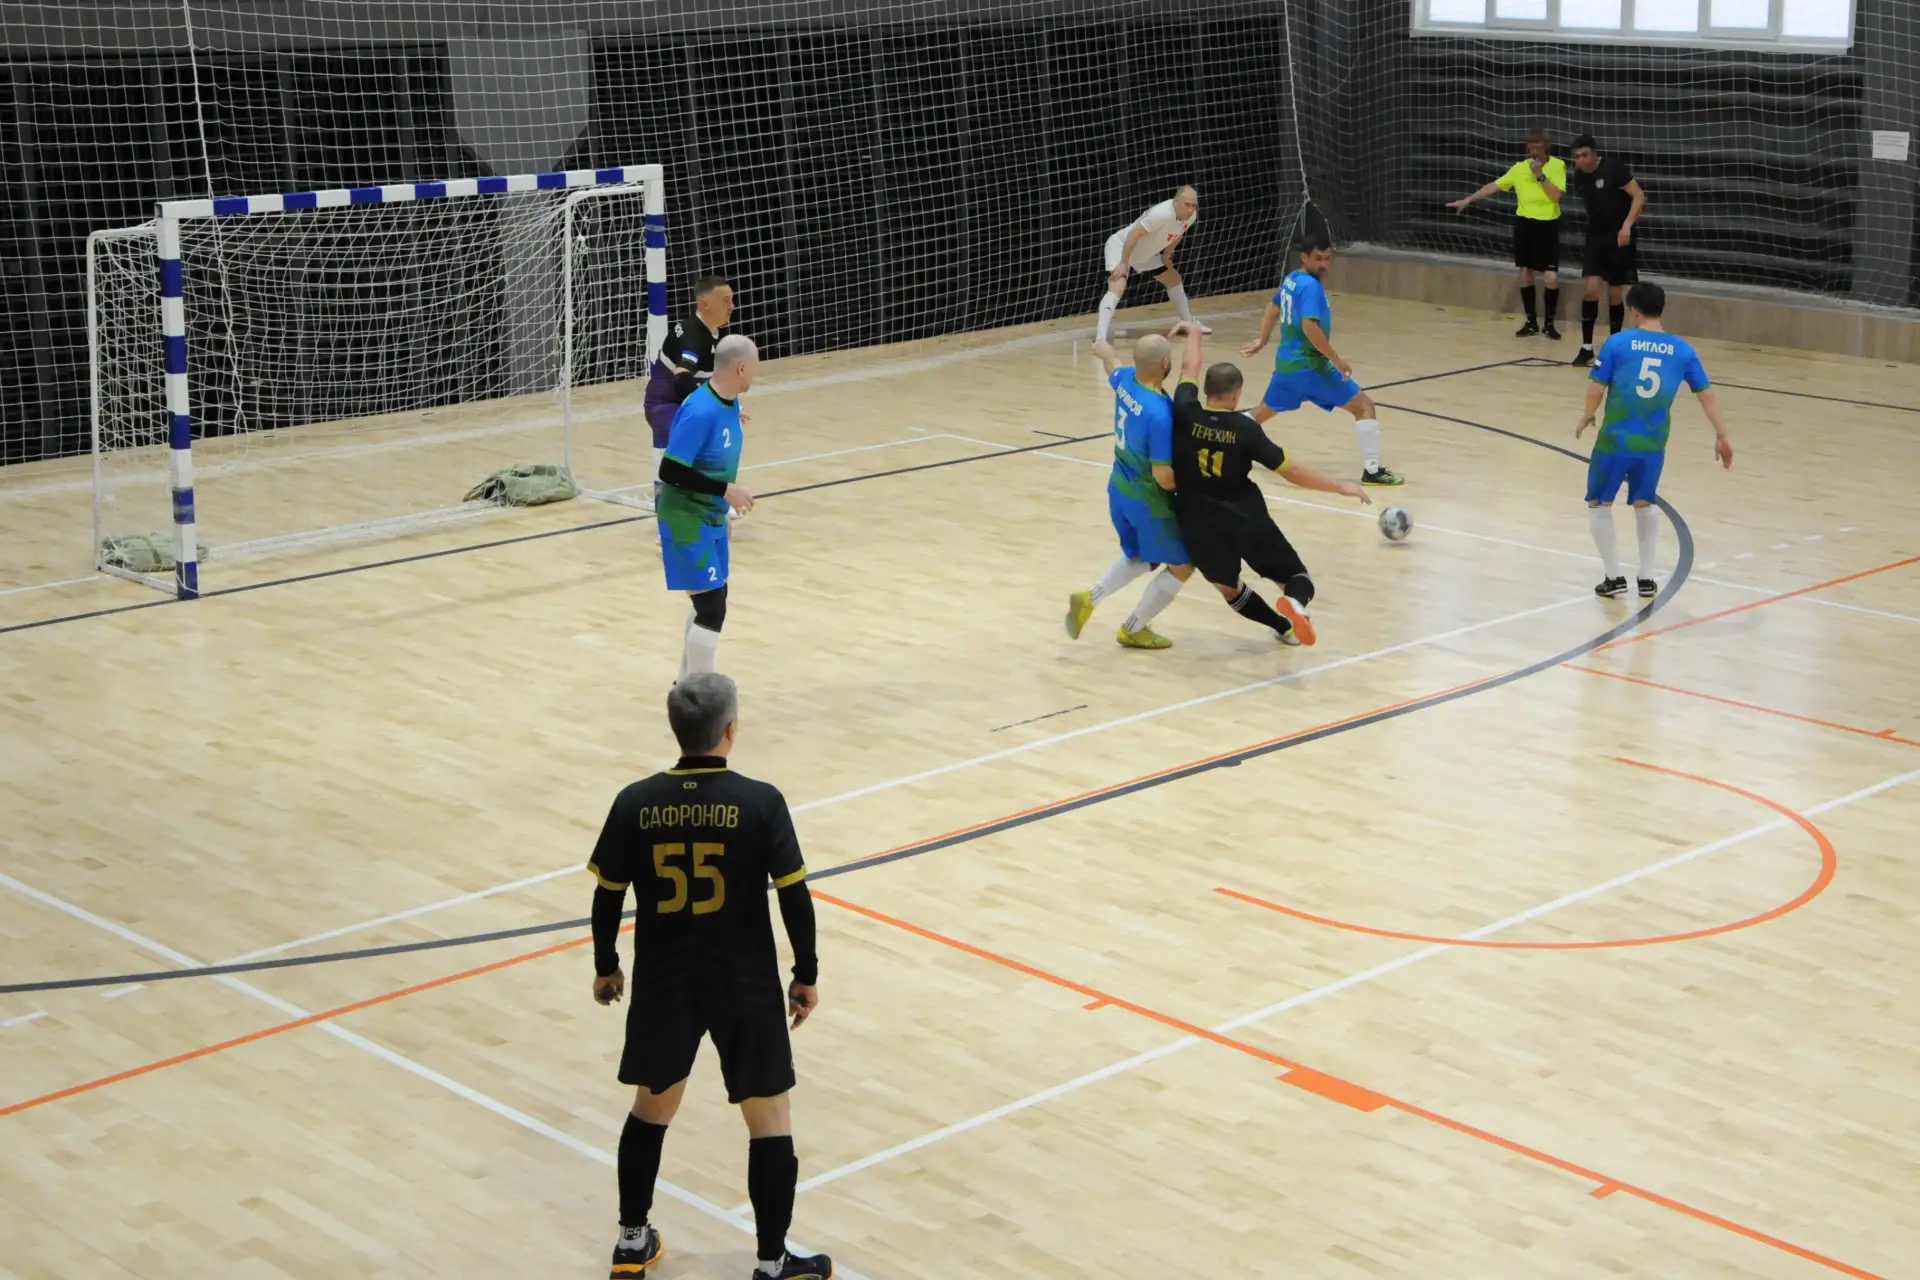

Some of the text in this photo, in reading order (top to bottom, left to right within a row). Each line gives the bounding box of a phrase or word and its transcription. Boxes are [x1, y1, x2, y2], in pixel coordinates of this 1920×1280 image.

[1631, 340, 1674, 355] БИГЛОВ
[1635, 357, 1662, 399] 5
[722, 428, 732, 449] 2
[1114, 406, 1128, 450] 3
[1191, 423, 1236, 445] ТЕРЕХИН
[1197, 448, 1224, 478] 11
[708, 566, 718, 582] 2
[639, 804, 740, 829] САФРОНОВ
[652, 842, 725, 915] 55
